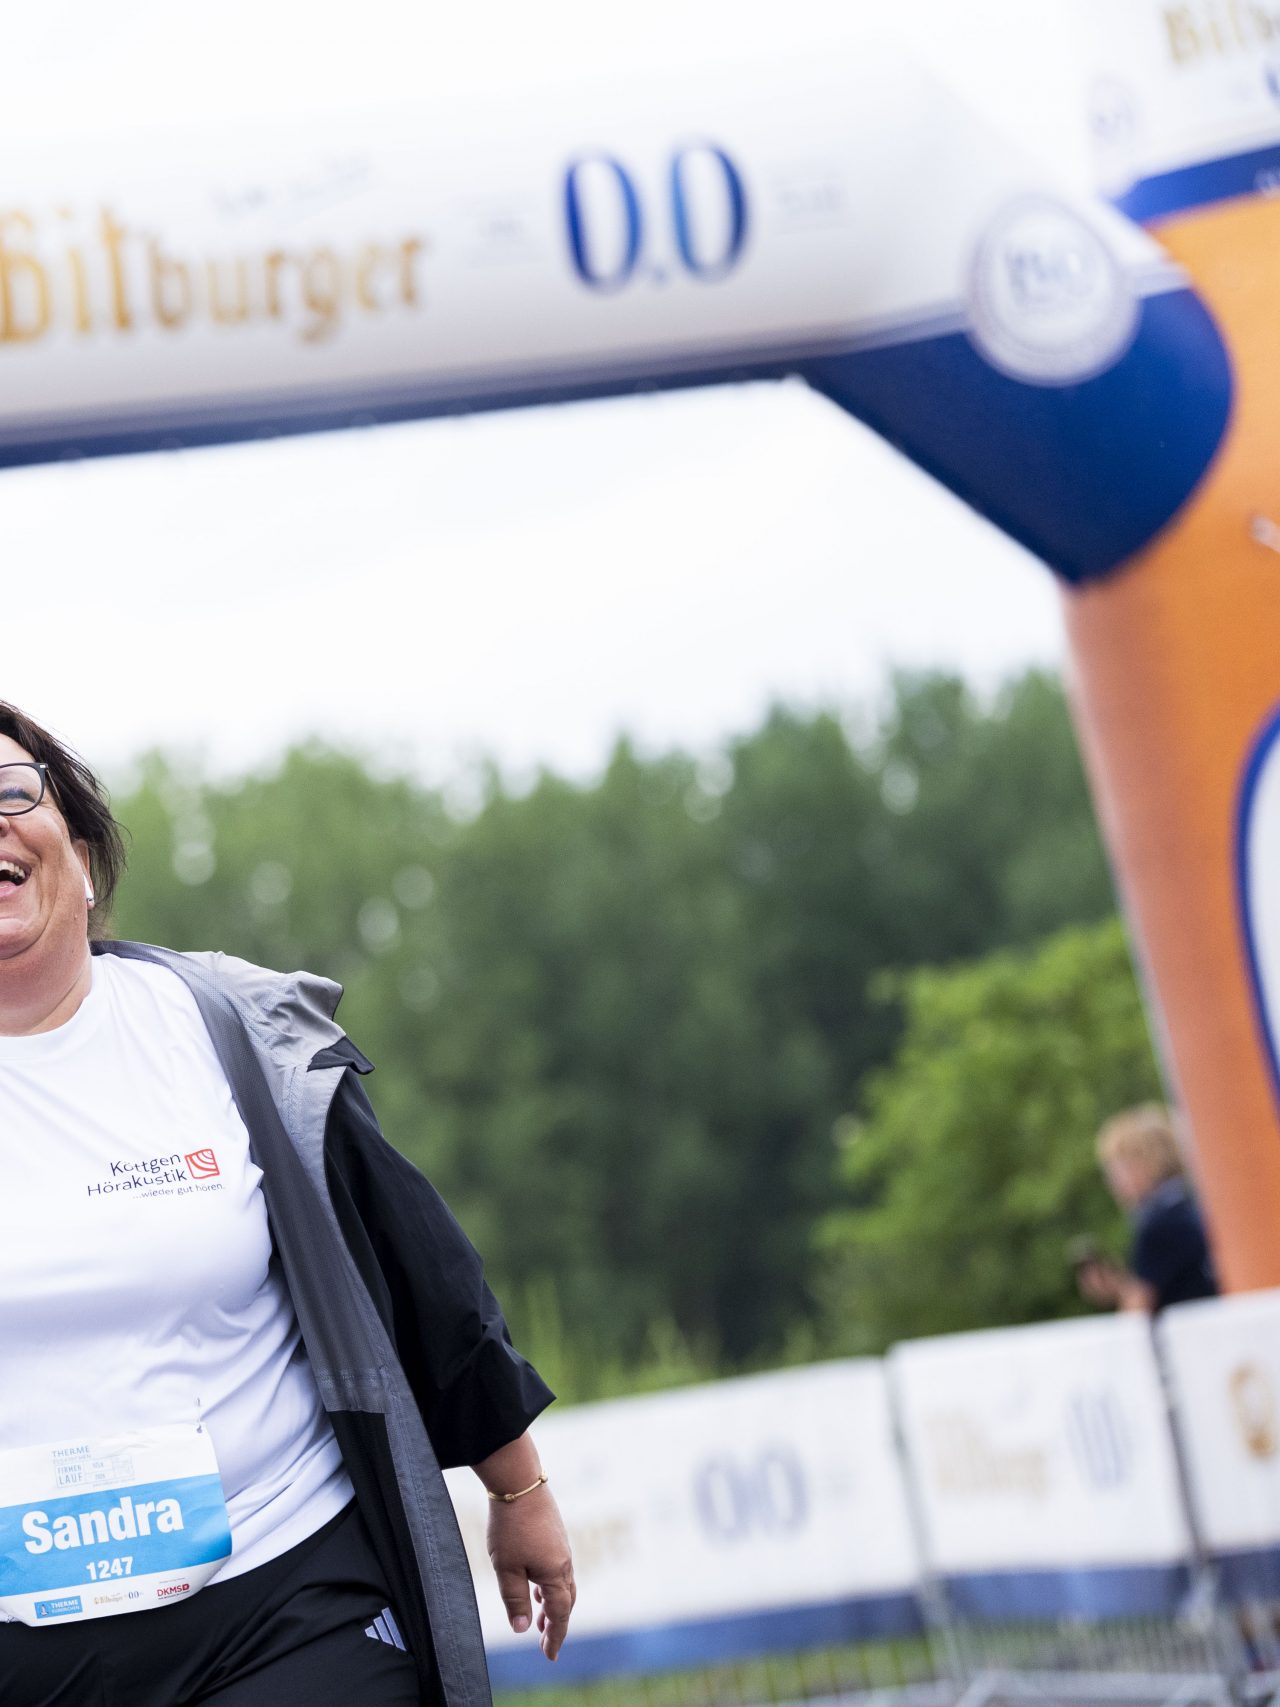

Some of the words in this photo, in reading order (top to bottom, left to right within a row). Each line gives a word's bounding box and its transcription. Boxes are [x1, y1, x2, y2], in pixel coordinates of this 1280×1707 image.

[562, 139, 749, 294] 0.0
[87, 1169, 188, 1197] Hörakustik
[177, 1185, 195, 1196] gut
[51, 1445, 90, 1457] THERME
[22, 1496, 184, 1555] Sandra
[86, 1556, 133, 1581] 1247
[156, 1584, 183, 1598] DKMS
